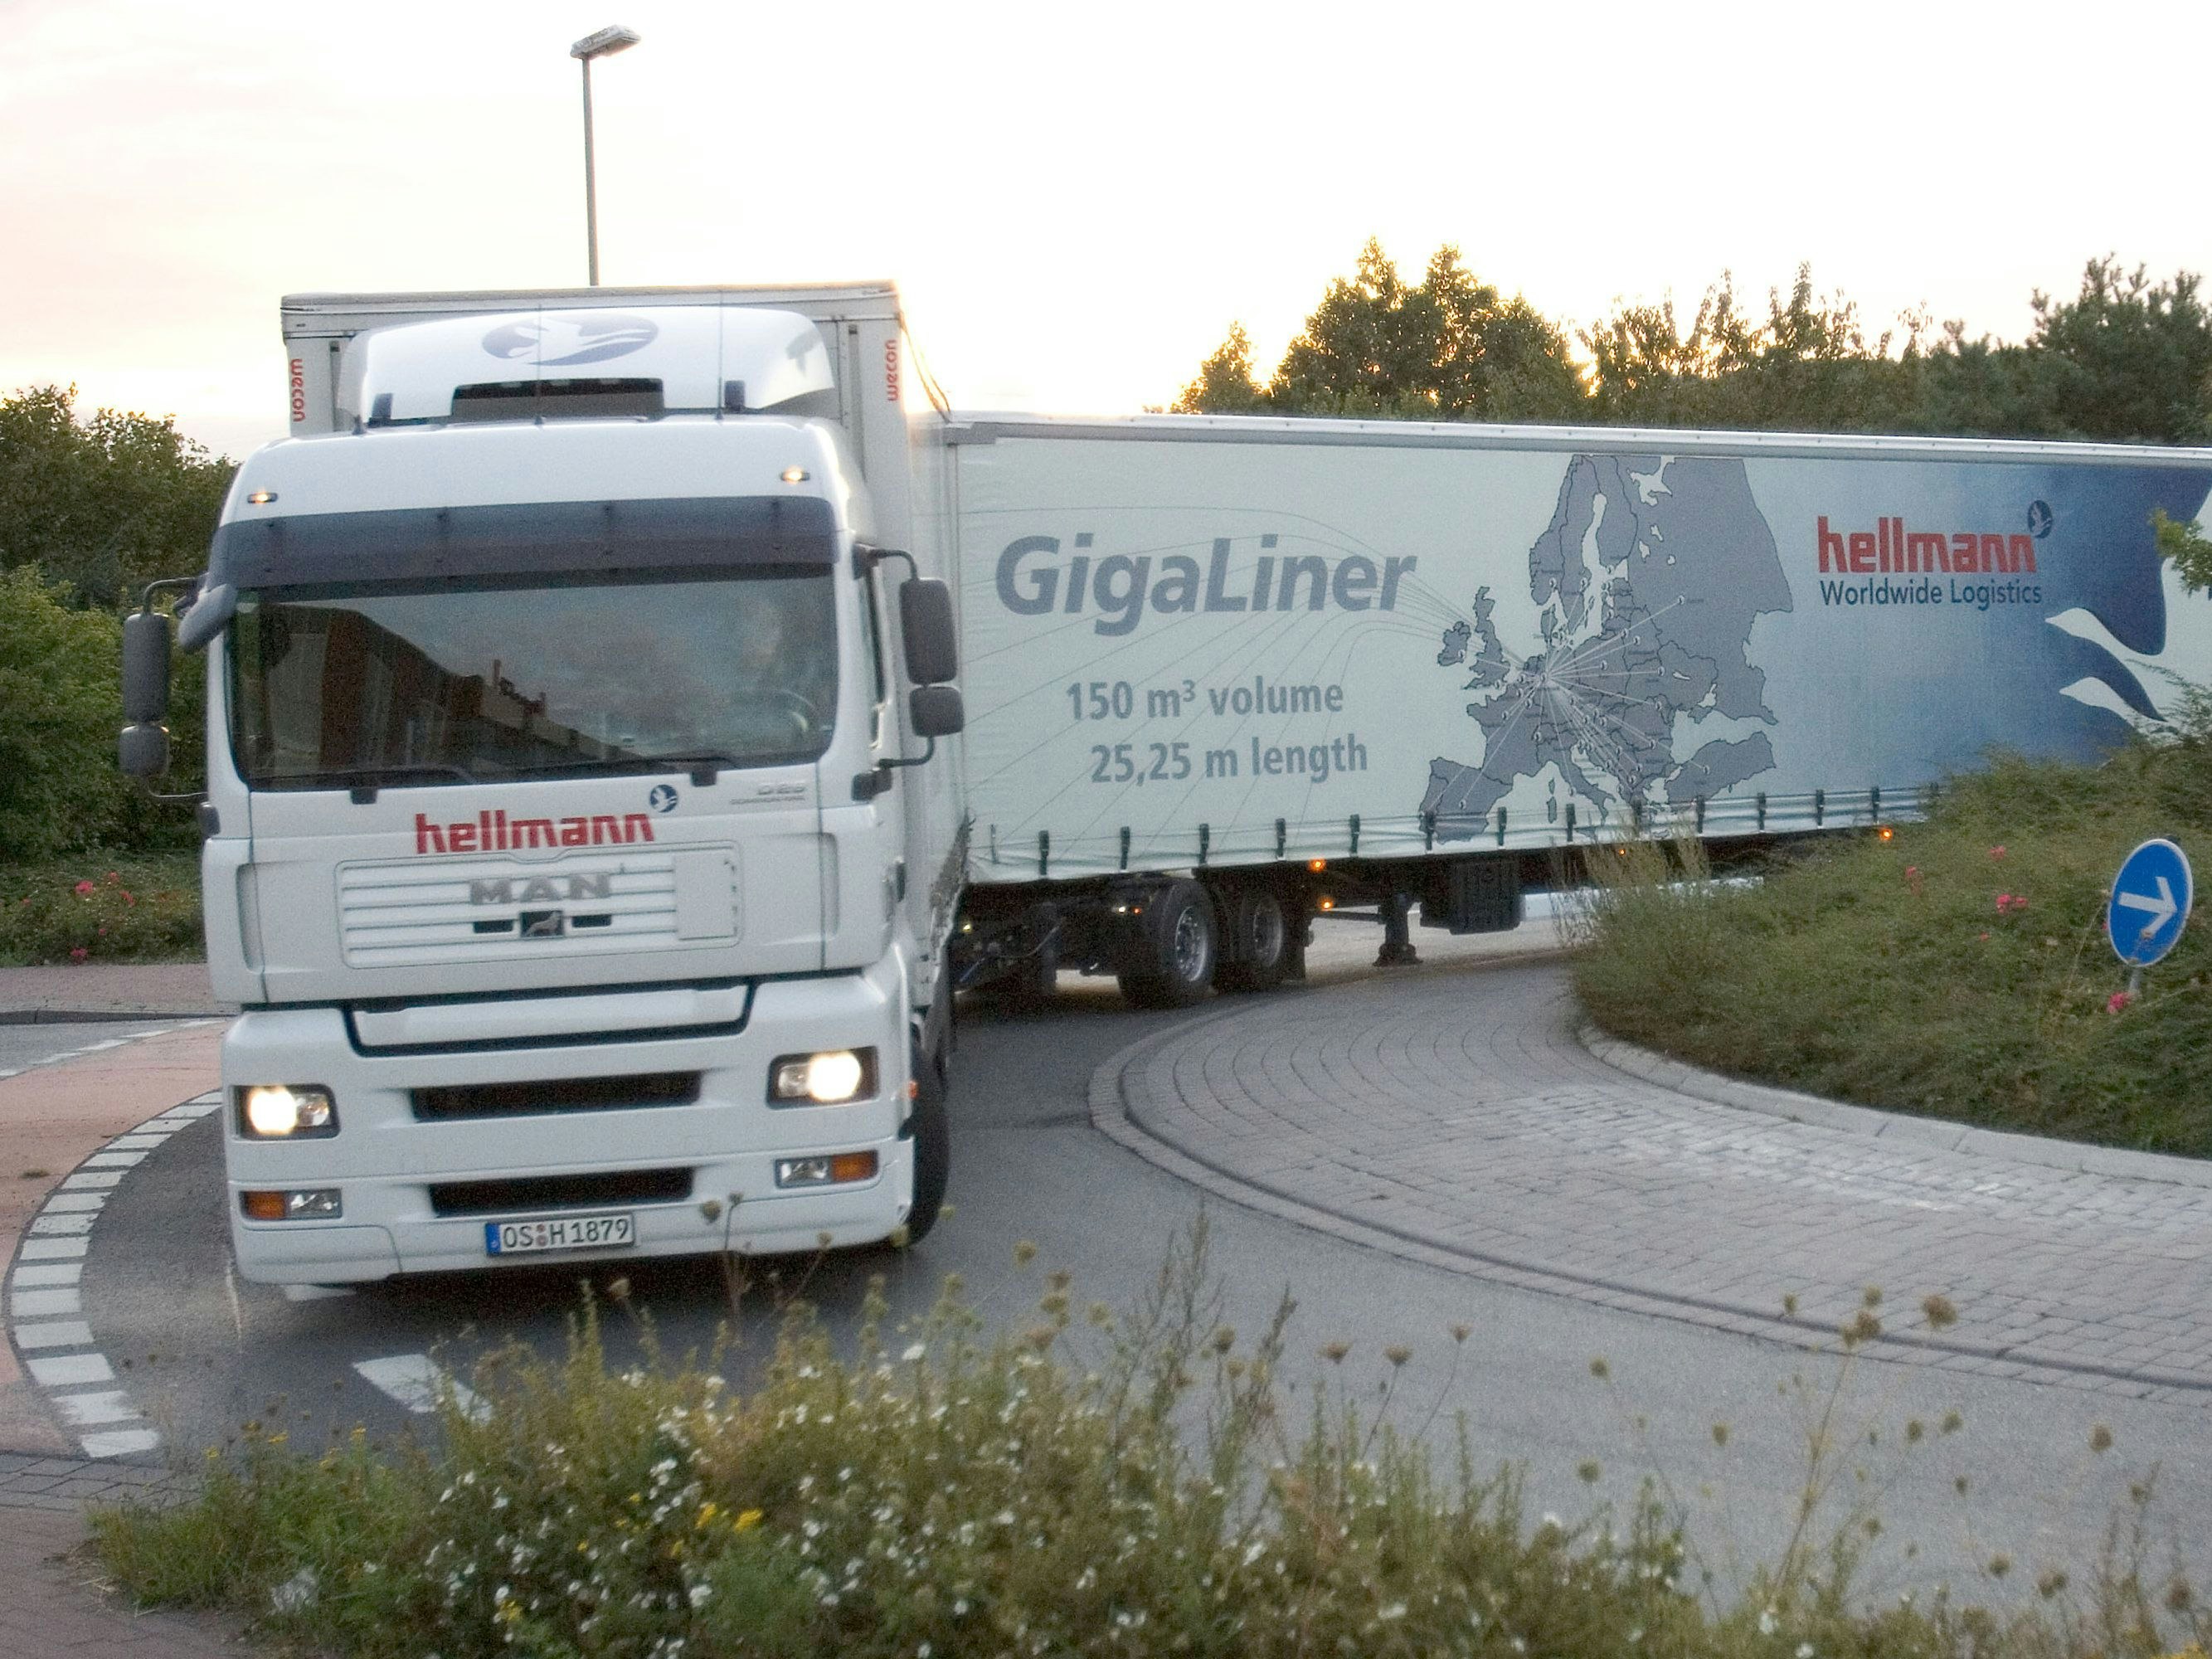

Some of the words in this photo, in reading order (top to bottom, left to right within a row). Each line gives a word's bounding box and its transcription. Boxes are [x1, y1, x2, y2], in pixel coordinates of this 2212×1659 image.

[290, 358, 306, 422] wecon
[885, 338, 899, 401] wecon
[1817, 515, 2037, 573] hellmann
[996, 533, 1417, 637] GigaLiner
[1820, 577, 1942, 606] Worldwide
[1950, 579, 2043, 611] Logistics
[1066, 680, 1134, 721] 150
[1208, 675, 1344, 717] volume
[1091, 742, 1192, 786] 25,25
[1205, 747, 1238, 779] m
[1251, 732, 1369, 784] length
[415, 809, 655, 854] hellmann
[470, 873, 611, 905] MAN
[571, 1218, 630, 1243] 1879
